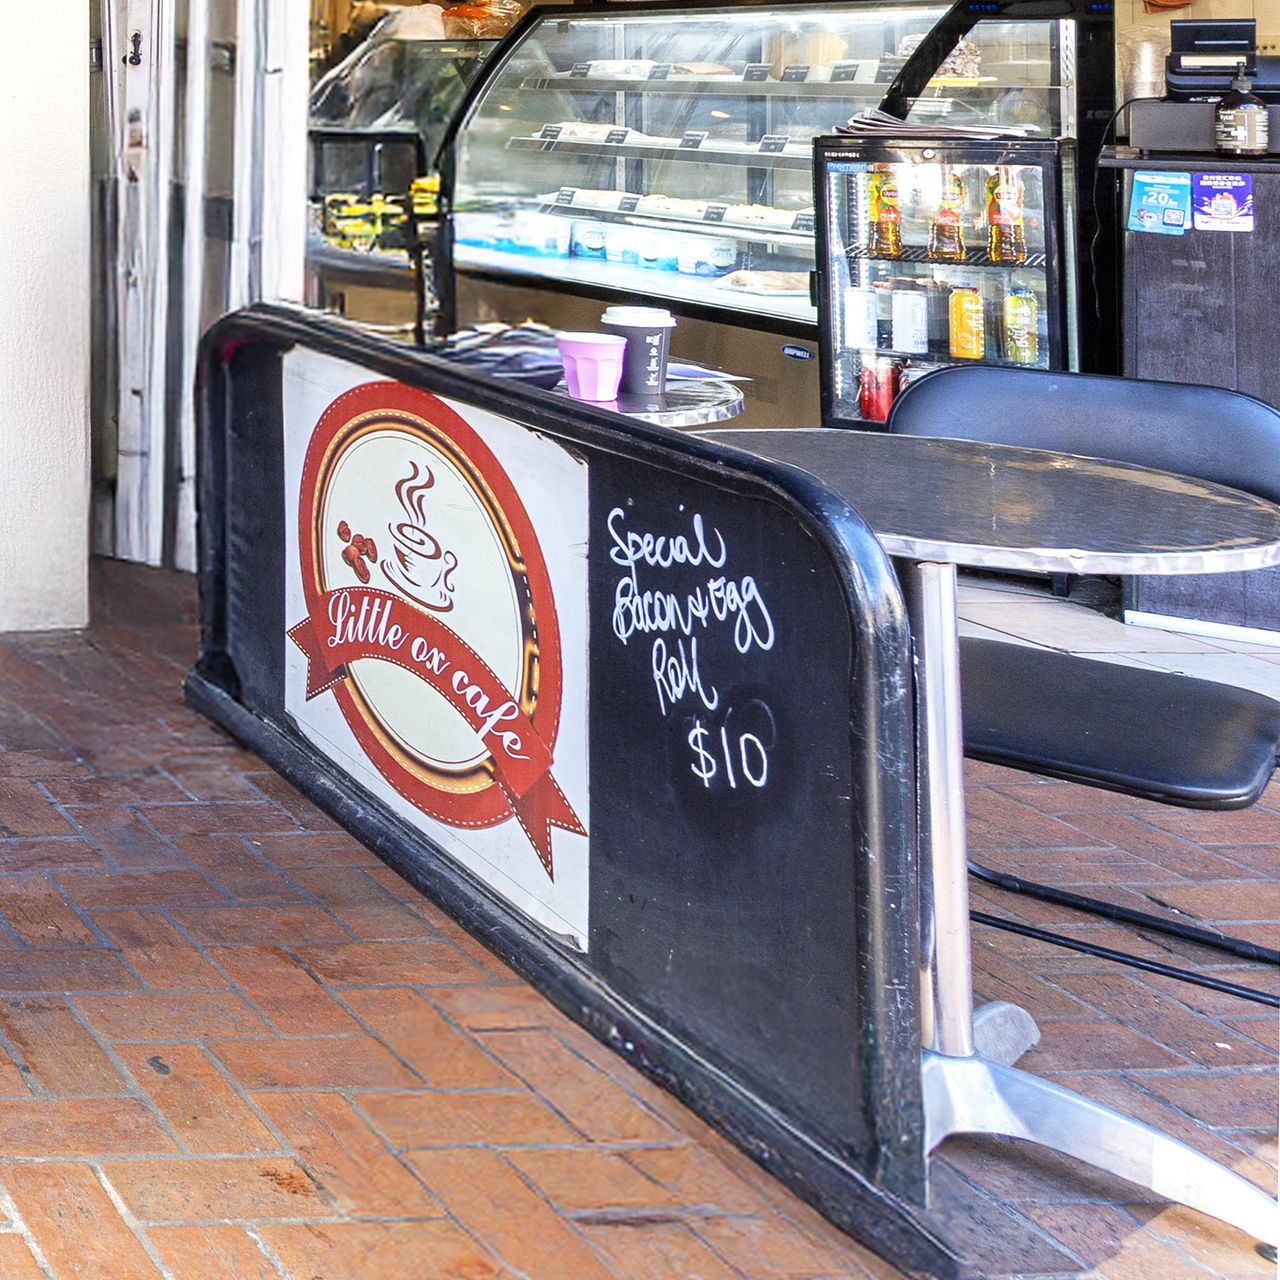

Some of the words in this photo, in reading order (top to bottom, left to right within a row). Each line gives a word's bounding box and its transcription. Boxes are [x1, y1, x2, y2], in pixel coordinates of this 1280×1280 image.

[608, 503, 727, 573] Special
[613, 577, 692, 644] Bacon
[327, 591, 410, 649] Little
[411, 636, 450, 676] ox
[452, 668, 531, 761] cafe
[651, 639, 718, 716] Roll
[689, 720, 767, 789] $10
